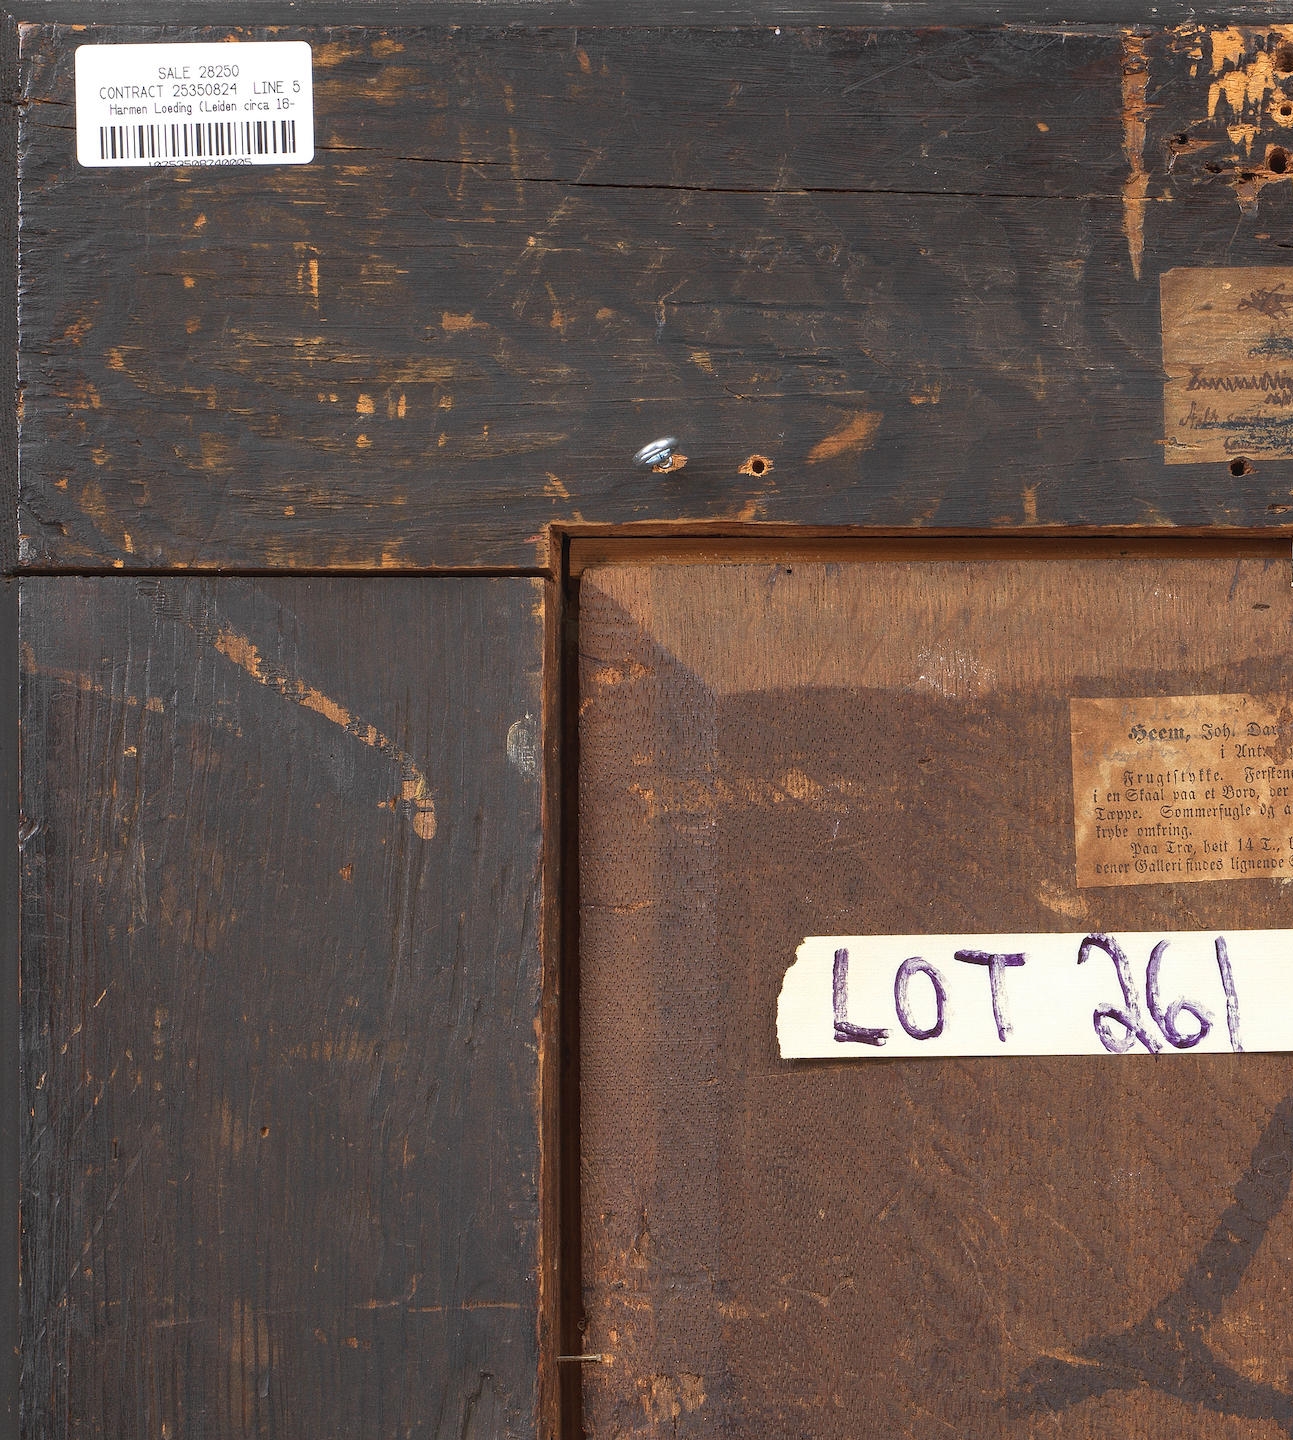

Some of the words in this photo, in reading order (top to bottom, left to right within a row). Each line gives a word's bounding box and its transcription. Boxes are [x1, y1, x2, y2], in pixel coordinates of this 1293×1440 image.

[159, 67, 190, 80] SALE
[199, 65, 239, 78] 28250
[100, 85, 163, 99] CONTRACT
[172, 83, 237, 97] 25350824
[254, 81, 284, 95] LINE
[293, 81, 300, 93] 5
[110, 103, 147, 115] Harmen
[154, 102, 192, 115] Loeding
[200, 101, 237, 113] (Leiden
[244, 100, 269, 111] circa
[277, 98, 295, 110] 16-
[1128, 724, 1191, 744] Heem,
[1220, 745, 1225, 758] i
[1093, 790, 1097, 803] i
[1107, 792, 1120, 802] en
[1173, 790, 1195, 803] paa
[1205, 788, 1216, 800] et
[1222, 786, 1260, 800] Bord,
[1269, 785, 1288, 797] der
[1160, 804, 1251, 820] Sommerfugle
[1137, 823, 1193, 839] omkring.
[1131, 842, 1158, 858] Paa
[1237, 838, 1254, 851] 14
[1096, 862, 1129, 874] dener
[1135, 859, 1182, 873] Galleri
[832, 948, 1026, 1044] LOT
[1078, 932, 1245, 1054] 261
